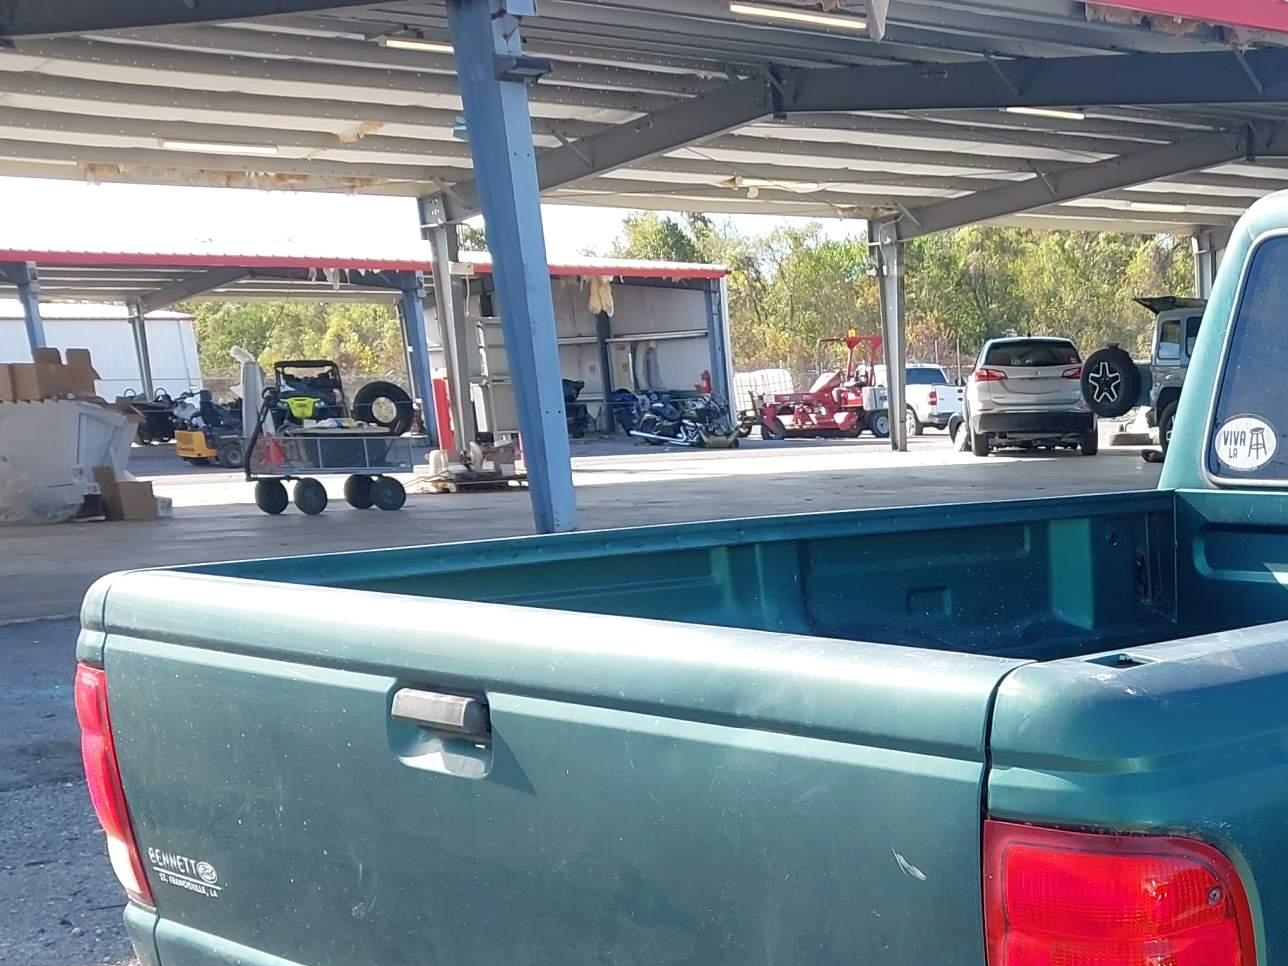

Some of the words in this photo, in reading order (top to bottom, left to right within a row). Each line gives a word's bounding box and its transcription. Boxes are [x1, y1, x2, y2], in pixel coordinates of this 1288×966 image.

[1223, 430, 1246, 446] VIVA
[1228, 448, 1238, 459] LA
[148, 847, 197, 877] BENNETT
